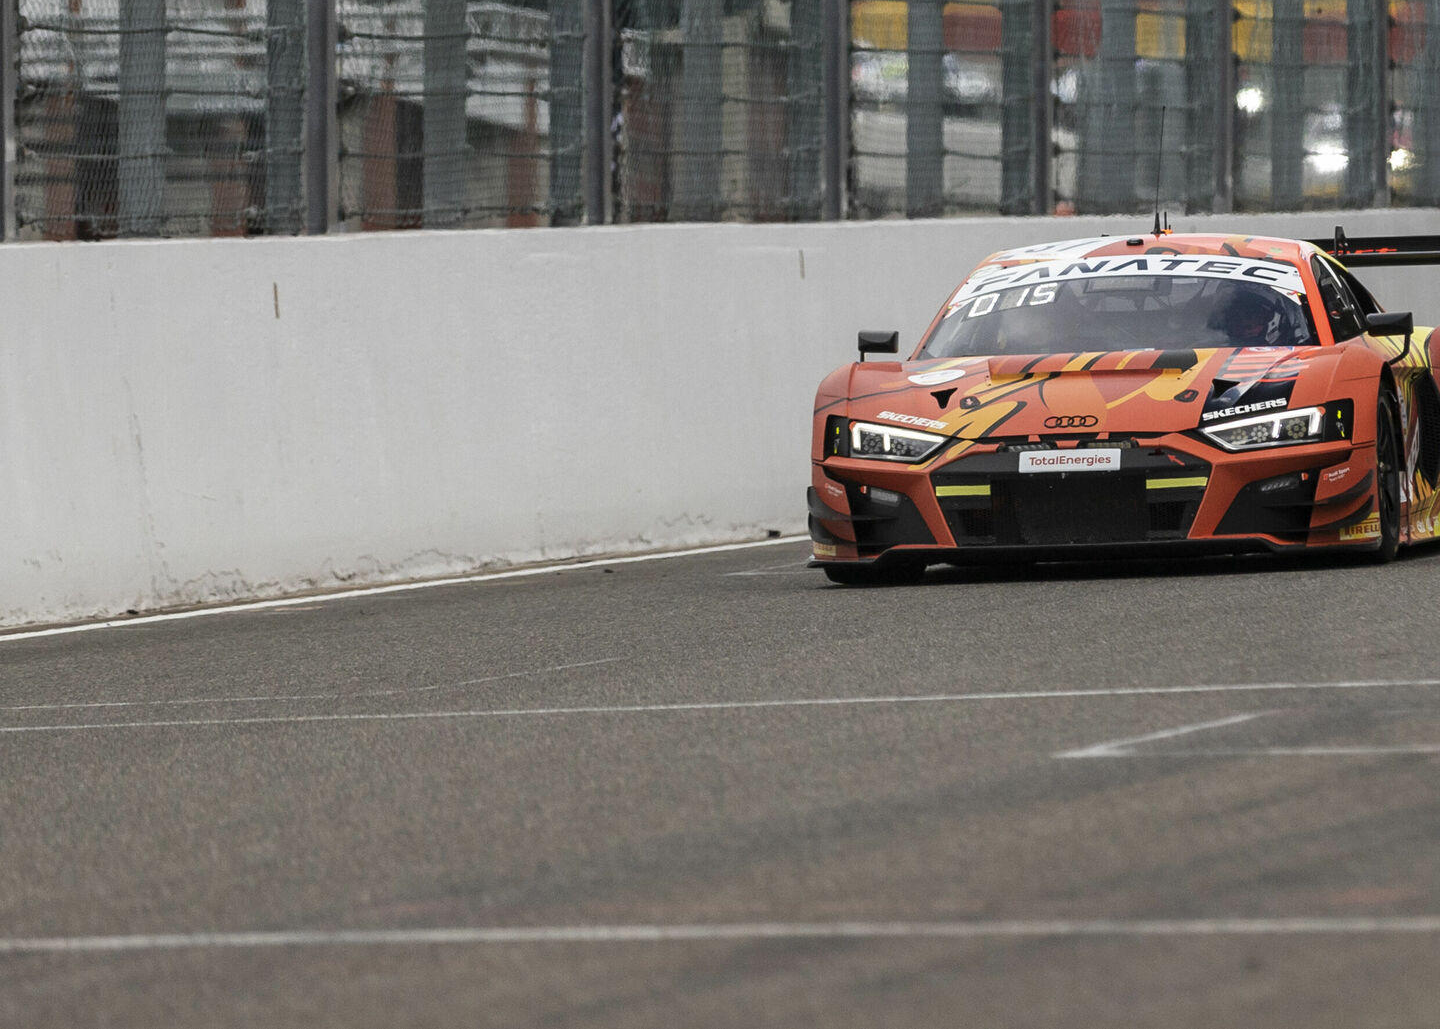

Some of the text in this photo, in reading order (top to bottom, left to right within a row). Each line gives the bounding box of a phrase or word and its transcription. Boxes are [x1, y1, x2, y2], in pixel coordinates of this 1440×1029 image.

[971, 258, 1289, 294] FANATEC
[876, 410, 949, 430] SKECHERS
[1202, 397, 1288, 421] SKECHERS
[1029, 454, 1112, 467] TotalEnergies
